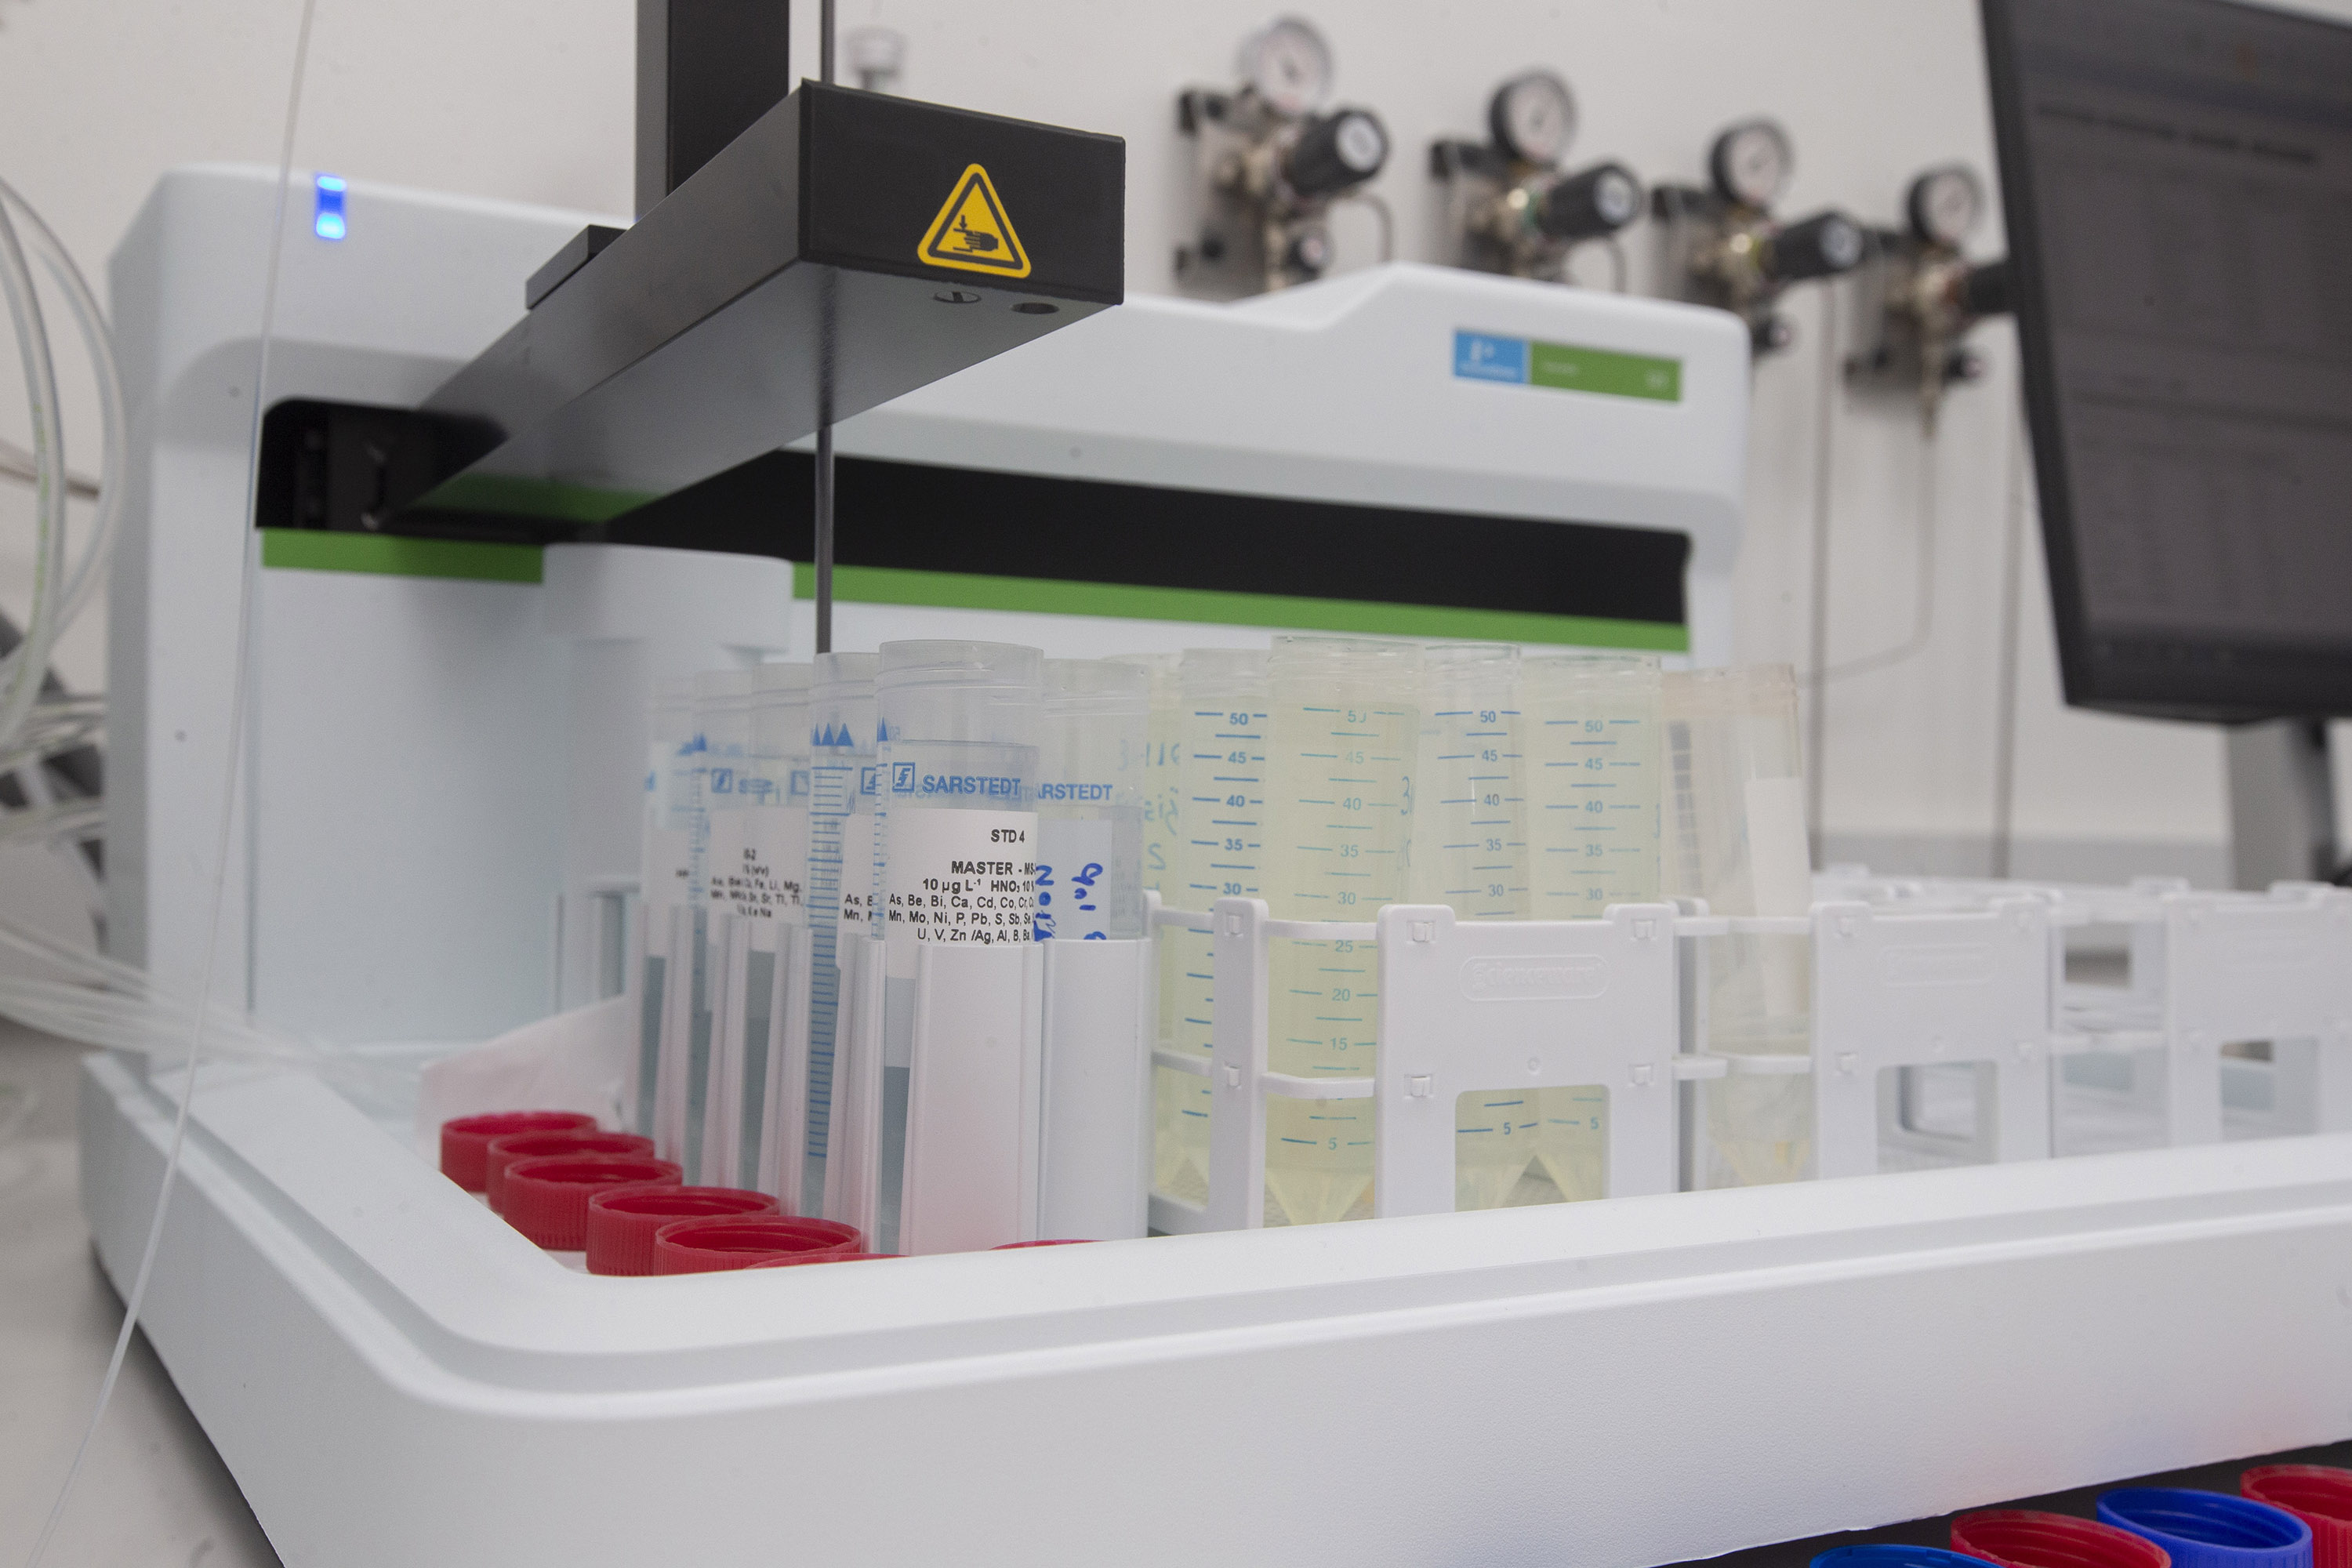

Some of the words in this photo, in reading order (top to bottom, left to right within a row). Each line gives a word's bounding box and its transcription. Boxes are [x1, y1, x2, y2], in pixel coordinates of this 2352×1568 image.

[1229, 713, 1249, 725] 50
[1480, 710, 1496, 723] 50
[1584, 720, 1603, 732] 50
[1228, 752, 1247, 764] 45
[1345, 751, 1364, 764] 45
[1482, 750, 1497, 762] 45
[1584, 758, 1603, 771] 45
[922, 775, 1022, 796] SARSTEDT
[1226, 795, 1245, 808] 40
[1342, 797, 1362, 811] 40
[1483, 793, 1500, 806] 40
[1584, 800, 1603, 813] 40
[990, 829, 1017, 844] STD
[1019, 829, 1025, 844] 4
[1225, 839, 1243, 851] 35
[1340, 844, 1359, 858] 35
[1486, 838, 1502, 851] 35
[1585, 844, 1603, 857] 35
[951, 861, 1013, 876] MASTER
[923, 877, 938, 891] 10
[1223, 883, 1241, 895] 30
[1488, 884, 1504, 897] 30
[844, 893, 862, 907] As,
[1338, 891, 1356, 905] 30
[1586, 887, 1603, 901] 30
[889, 893, 904, 907] As,
[908, 894, 926, 908] Be,
[931, 895, 946, 909] Bi,
[951, 895, 972, 909] Ca,
[977, 896, 996, 910] Cd,
[1000, 896, 1017, 910] Co,
[844, 909, 863, 923] Mn,
[889, 909, 906, 924] Mn,
[909, 910, 929, 925] Mo,
[934, 911, 951, 926] Ni,
[956, 912, 966, 926] P,
[971, 913, 991, 926] Pb,
[995, 913, 1005, 927] S,
[1008, 913, 1022, 926] Sb,
[917, 927, 931, 942] U,
[935, 928, 946, 942] V,
[949, 928, 966, 941] Zn
[996, 929, 1010, 943] Al,
[1013, 929, 1021, 943] B,
[1335, 939, 1353, 953] 25
[1332, 988, 1351, 1002] 20
[1330, 1037, 1348, 1051] 15
[1503, 1122, 1512, 1134] 5
[1590, 1116, 1599, 1129] 5
[1328, 1137, 1338, 1150] 5
